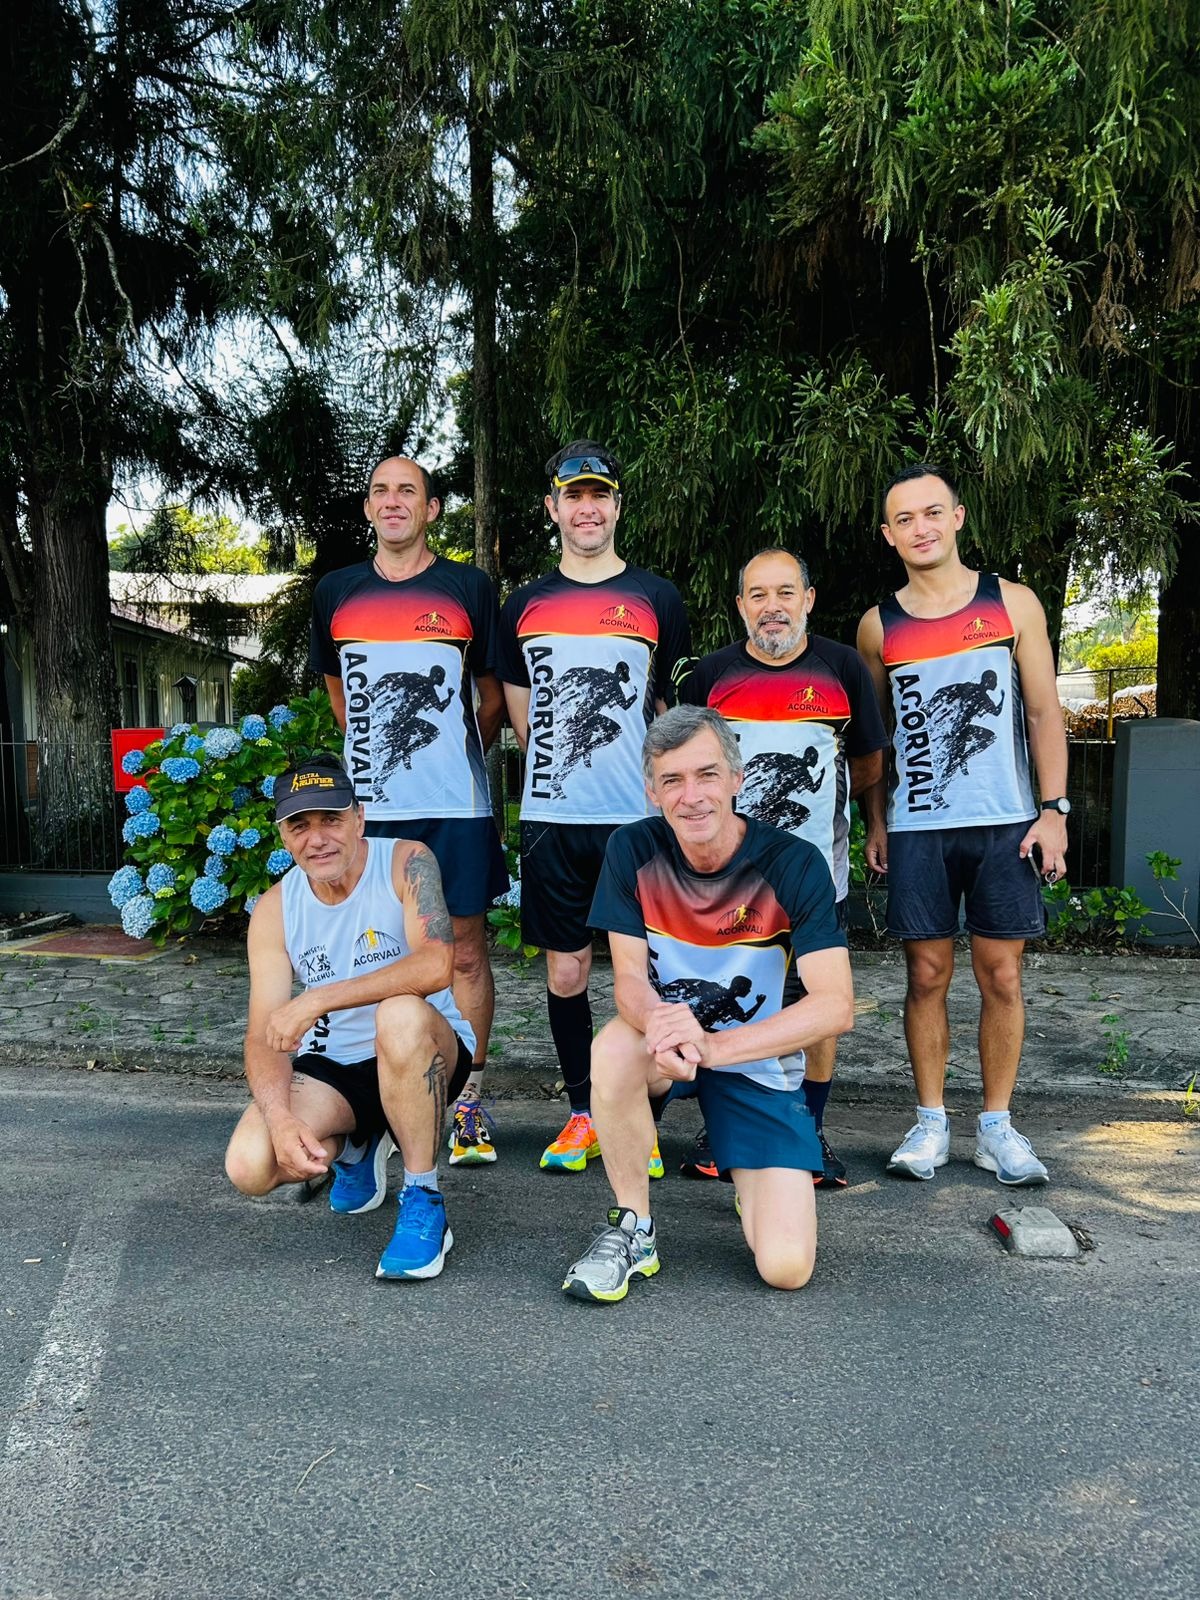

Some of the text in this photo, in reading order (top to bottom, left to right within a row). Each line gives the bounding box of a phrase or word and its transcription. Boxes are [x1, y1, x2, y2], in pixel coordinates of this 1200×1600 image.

[414, 624, 453, 635] ACORVALI
[600, 618, 640, 633] ACORVALI
[962, 631, 1000, 641] ACORVALI
[787, 703, 829, 714] ACORVALI
[344, 652, 374, 803] ACORVALI
[527, 646, 554, 800] ACORVALI
[895, 674, 934, 813] ACORVALI
[299, 772, 320, 780] ULTRA
[299, 777, 334, 787] RUNNER
[716, 924, 763, 936] ACORVALI
[353, 946, 402, 967] ACORVALI
